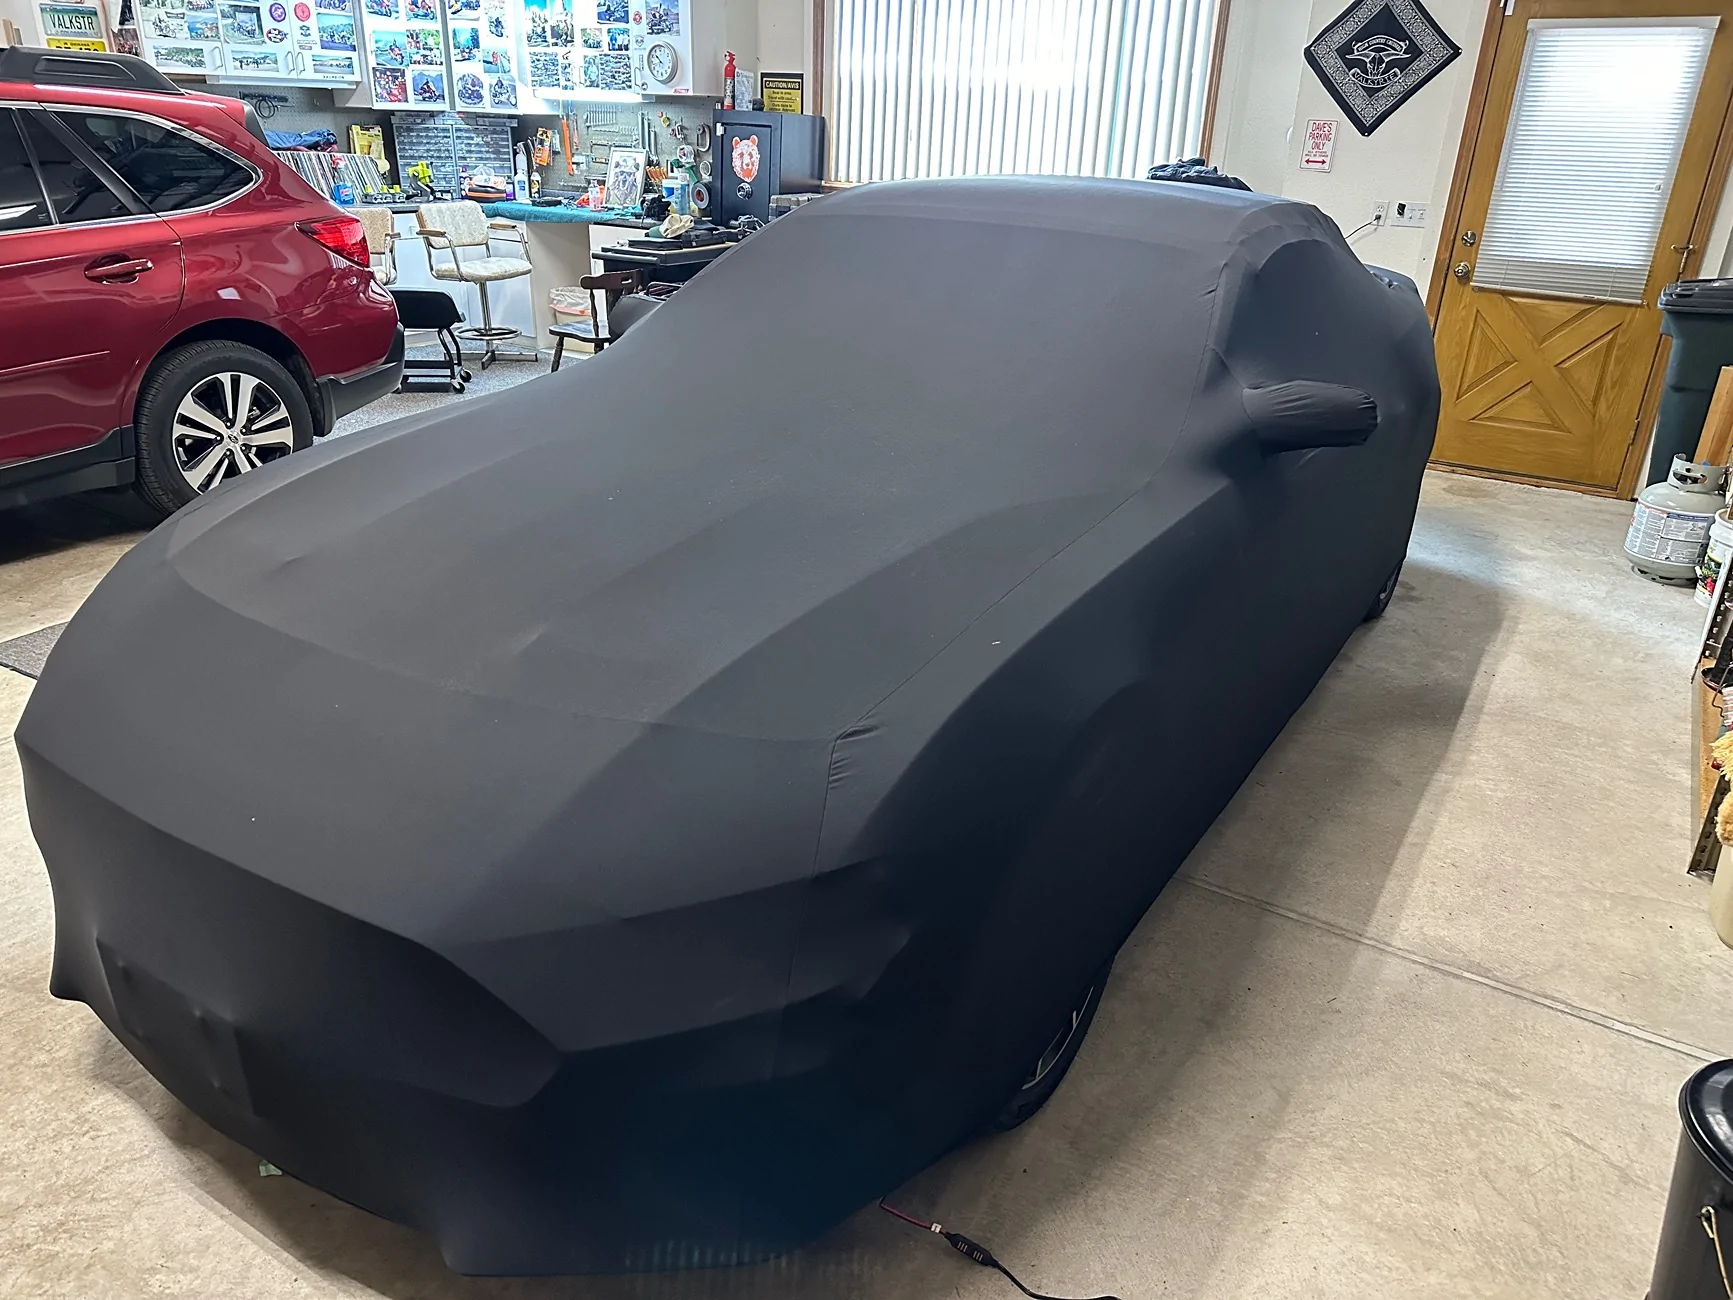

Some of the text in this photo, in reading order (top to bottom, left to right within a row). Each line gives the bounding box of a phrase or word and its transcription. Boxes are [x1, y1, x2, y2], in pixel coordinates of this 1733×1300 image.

[49, 14, 95, 30] VALKSTR
[1354, 72, 1397, 86] VALKYRIE
[1312, 122, 1332, 132] DAVE'S
[1309, 132, 1332, 141] PARKING
[1312, 141, 1326, 150] ONLY
